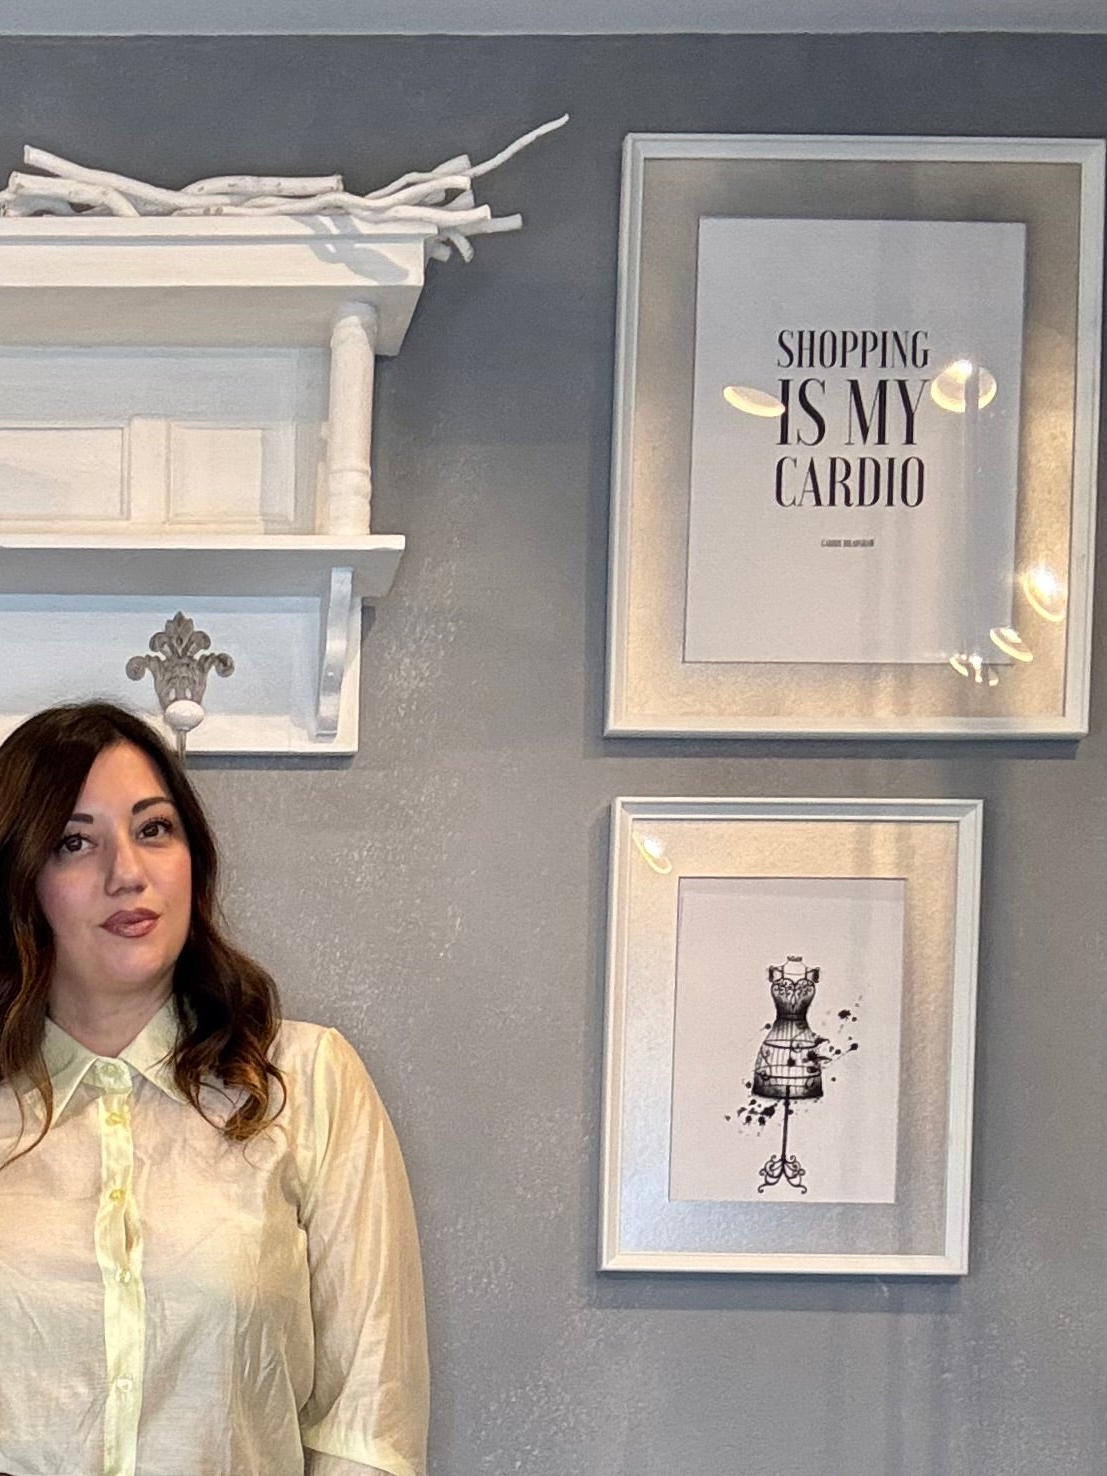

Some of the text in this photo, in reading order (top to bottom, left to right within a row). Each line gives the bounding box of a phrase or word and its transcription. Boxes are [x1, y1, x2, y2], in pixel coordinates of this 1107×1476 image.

[777, 329, 930, 369] SHOPPING
[776, 378, 931, 446] IS MY
[775, 456, 925, 507] CARDIO
